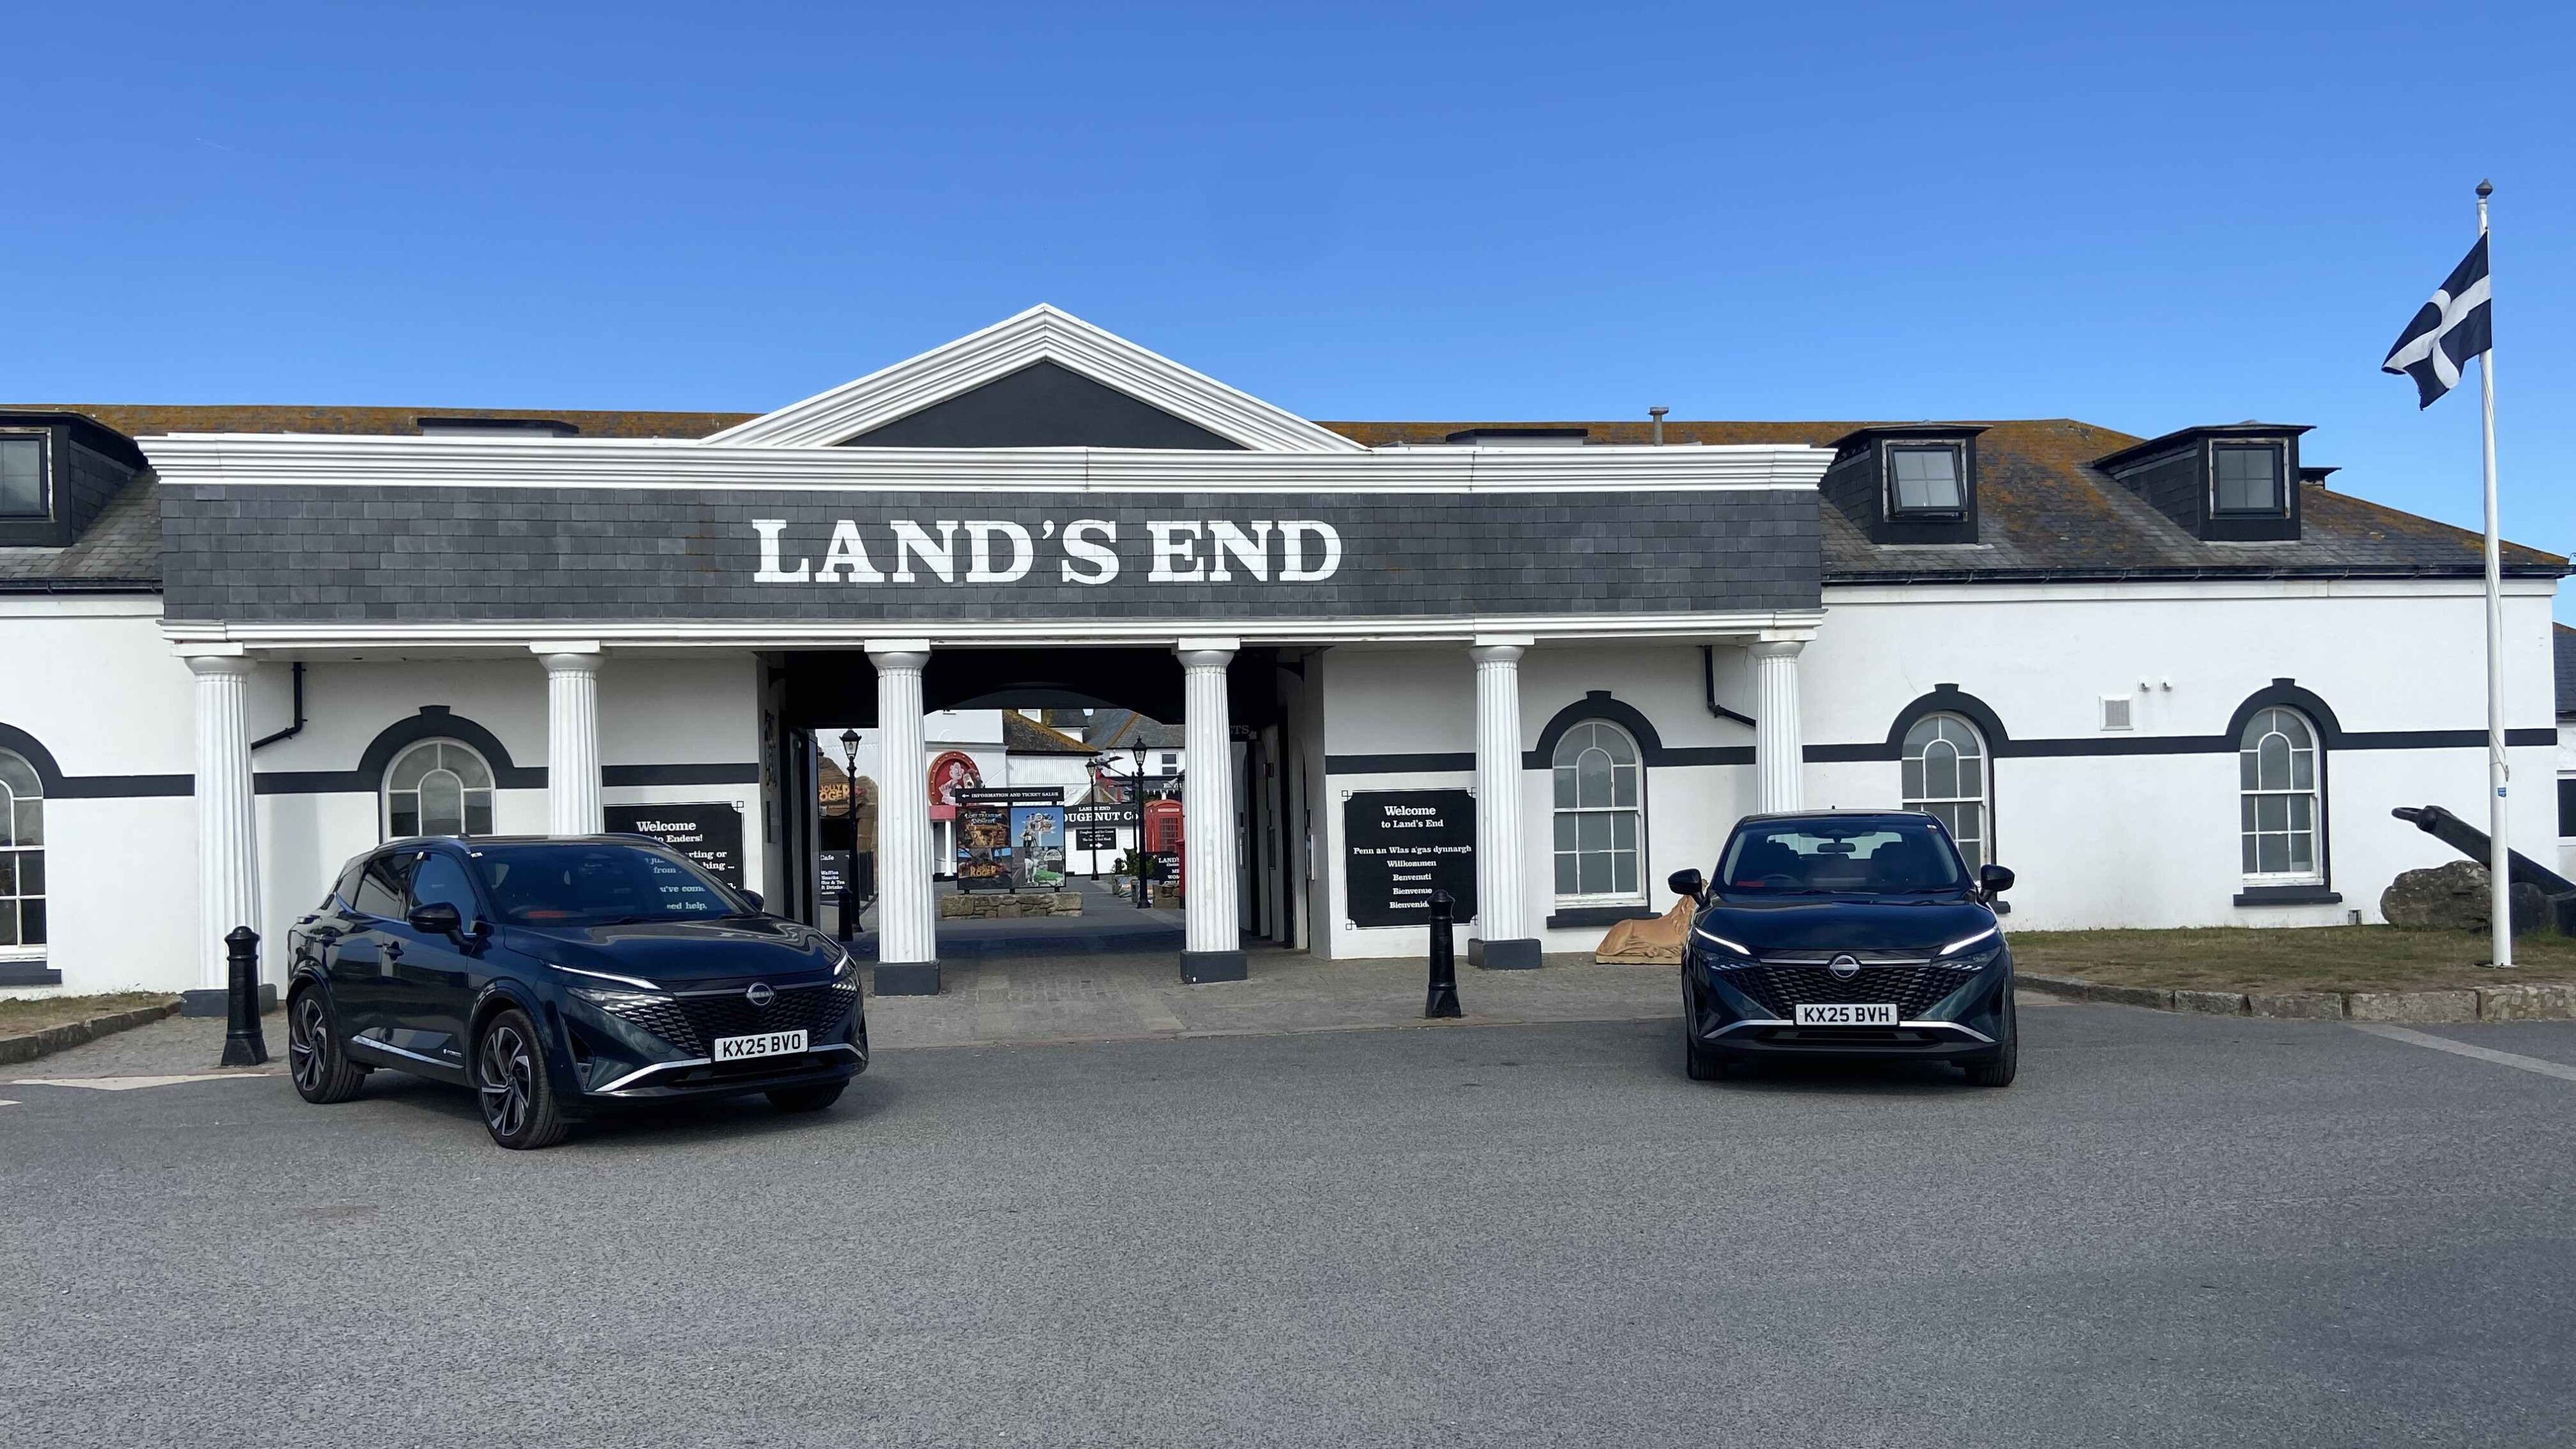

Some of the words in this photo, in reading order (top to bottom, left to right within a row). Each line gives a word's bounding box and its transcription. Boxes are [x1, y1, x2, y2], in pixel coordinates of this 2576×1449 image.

[752, 519, 1119, 584] LAND'S
[1146, 520, 1341, 582] END
[819, 784, 850, 801] OGER
[1384, 806, 1436, 817] Welcome
[1065, 812, 1121, 822] UGHNUT
[636, 820, 697, 832] Welcome
[1393, 820, 1423, 828] Land's
[1425, 819, 1444, 828] End
[666, 833, 703, 843] Enders!
[1433, 845, 1472, 855] dynnargh
[688, 851, 714, 860] rting
[1387, 860, 1437, 868] Willkommen
[1804, 1007, 1850, 1023] KX25
[1855, 1007, 1889, 1023] BVH
[723, 1037, 766, 1058] KX25
[771, 1033, 801, 1052] BVO
